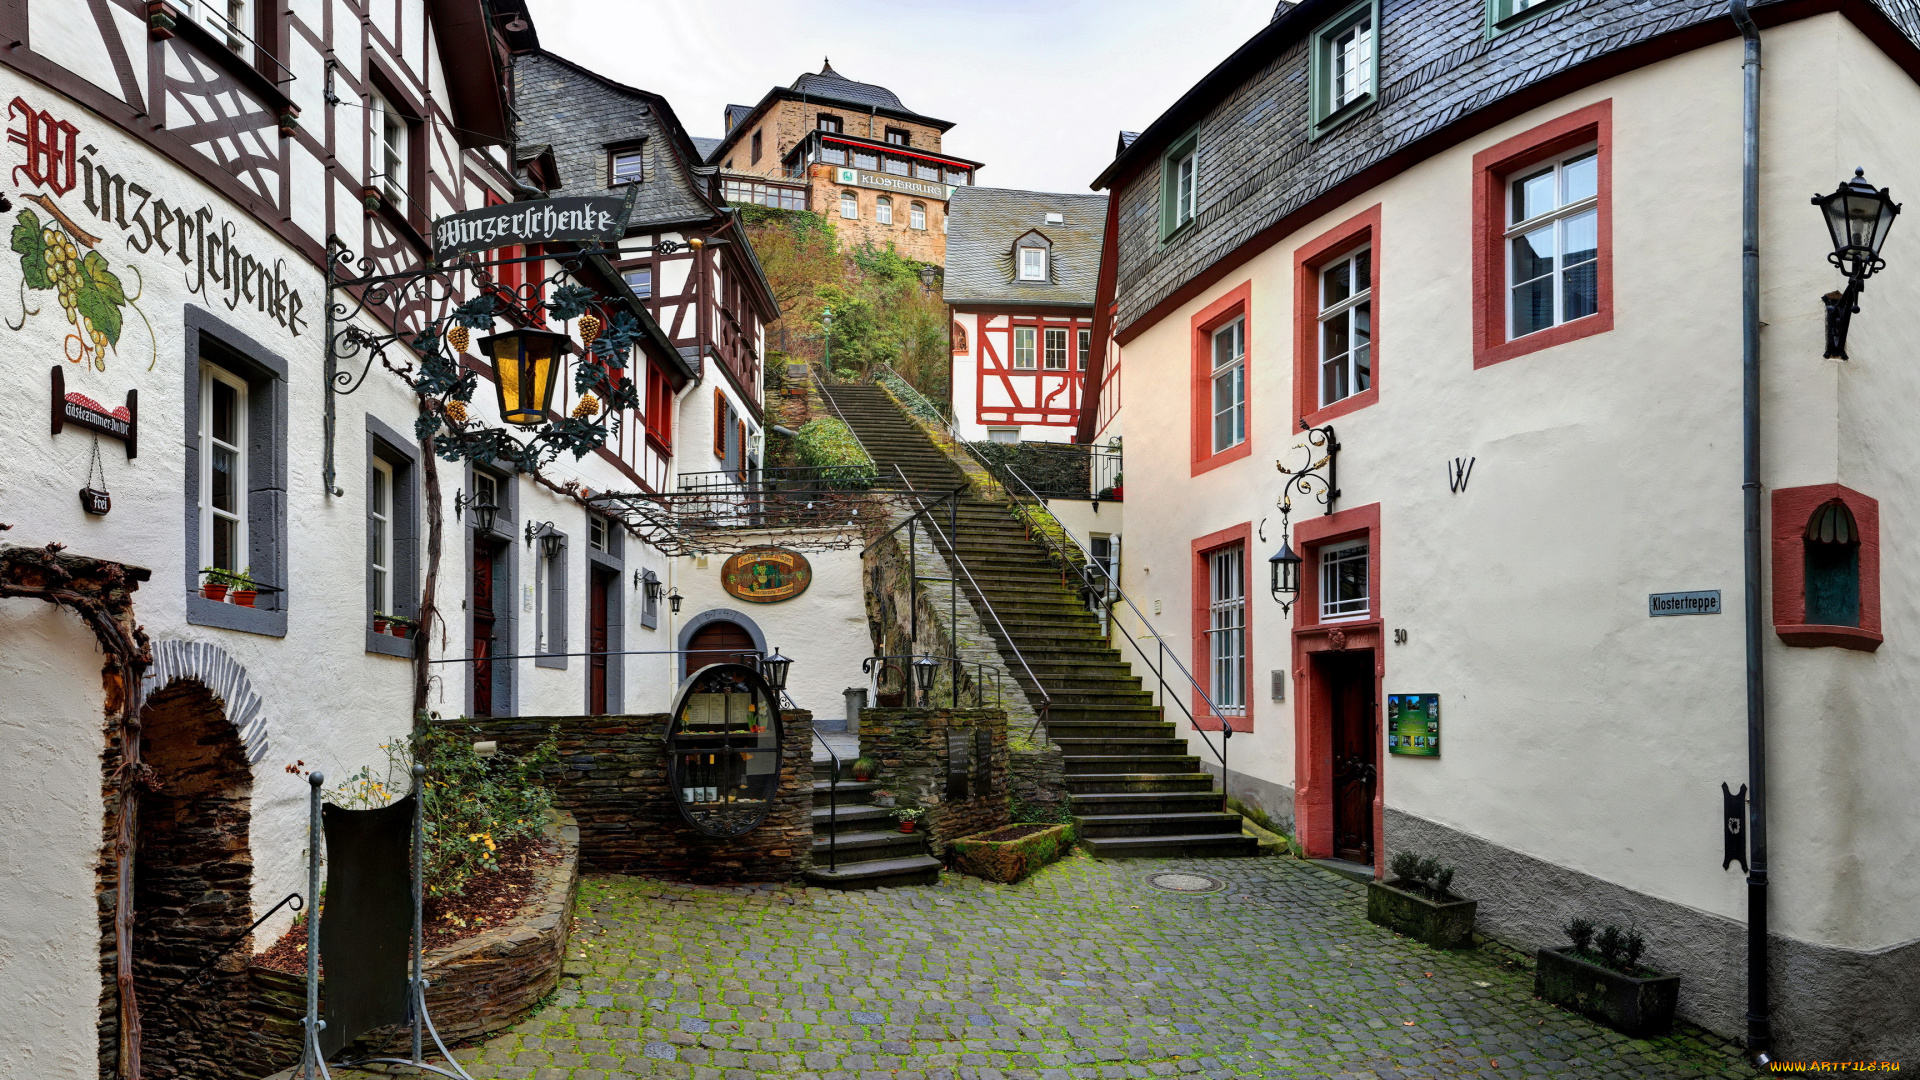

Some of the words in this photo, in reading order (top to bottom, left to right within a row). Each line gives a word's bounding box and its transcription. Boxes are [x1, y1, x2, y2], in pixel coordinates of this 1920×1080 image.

[861, 175, 942, 195] KLOSTERBURG
[94, 496, 107, 510] frei
[1652, 596, 1717, 612] Klostertreppe
[1394, 628, 1408, 644] 30
